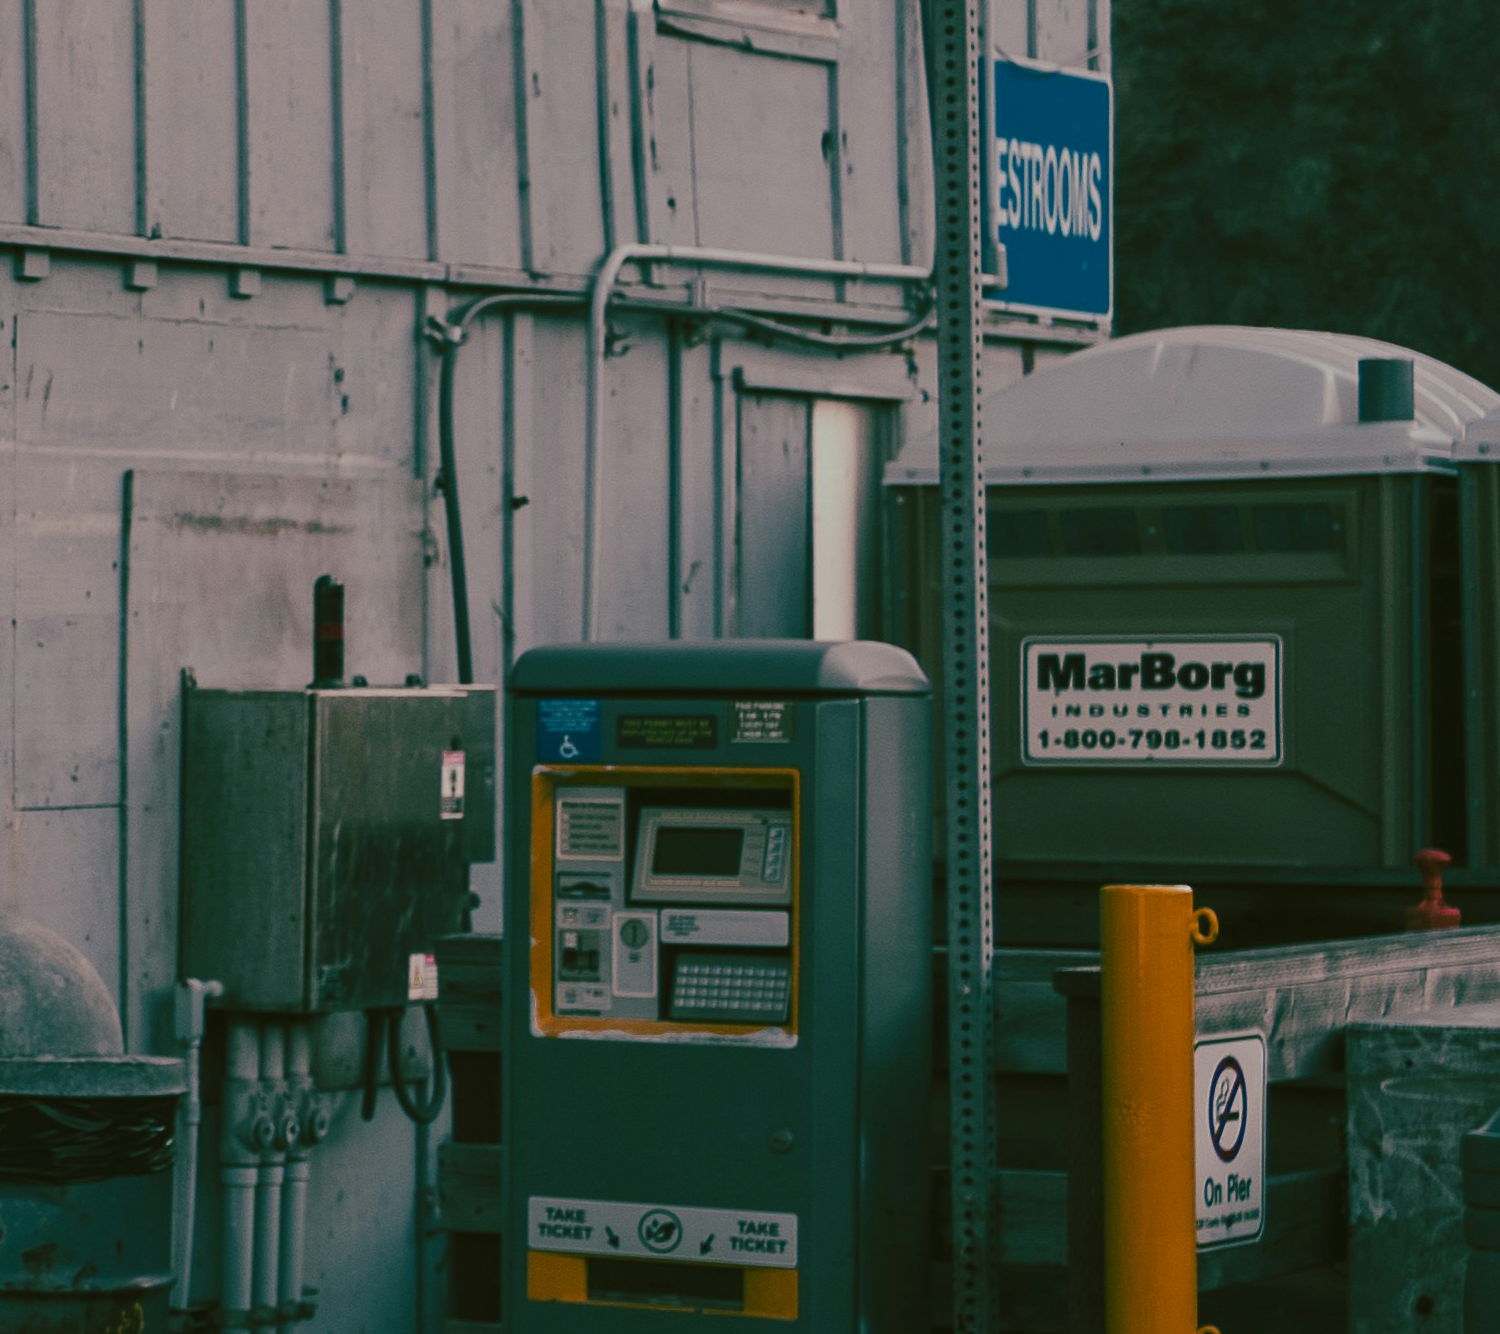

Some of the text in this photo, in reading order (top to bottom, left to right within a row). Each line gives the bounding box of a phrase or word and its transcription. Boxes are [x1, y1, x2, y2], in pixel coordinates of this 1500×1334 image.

[995, 136, 1102, 243] ESTROOMS
[1036, 652, 1267, 700] MarBorg
[1051, 703, 1252, 718] INDUSTRIES
[1204, 1172, 1252, 1208] On Pier
[546, 1206, 587, 1224] TAKE
[537, 1222, 594, 1241] TICKET
[737, 1219, 780, 1238] TAKE
[728, 1235, 788, 1255] TICKET
